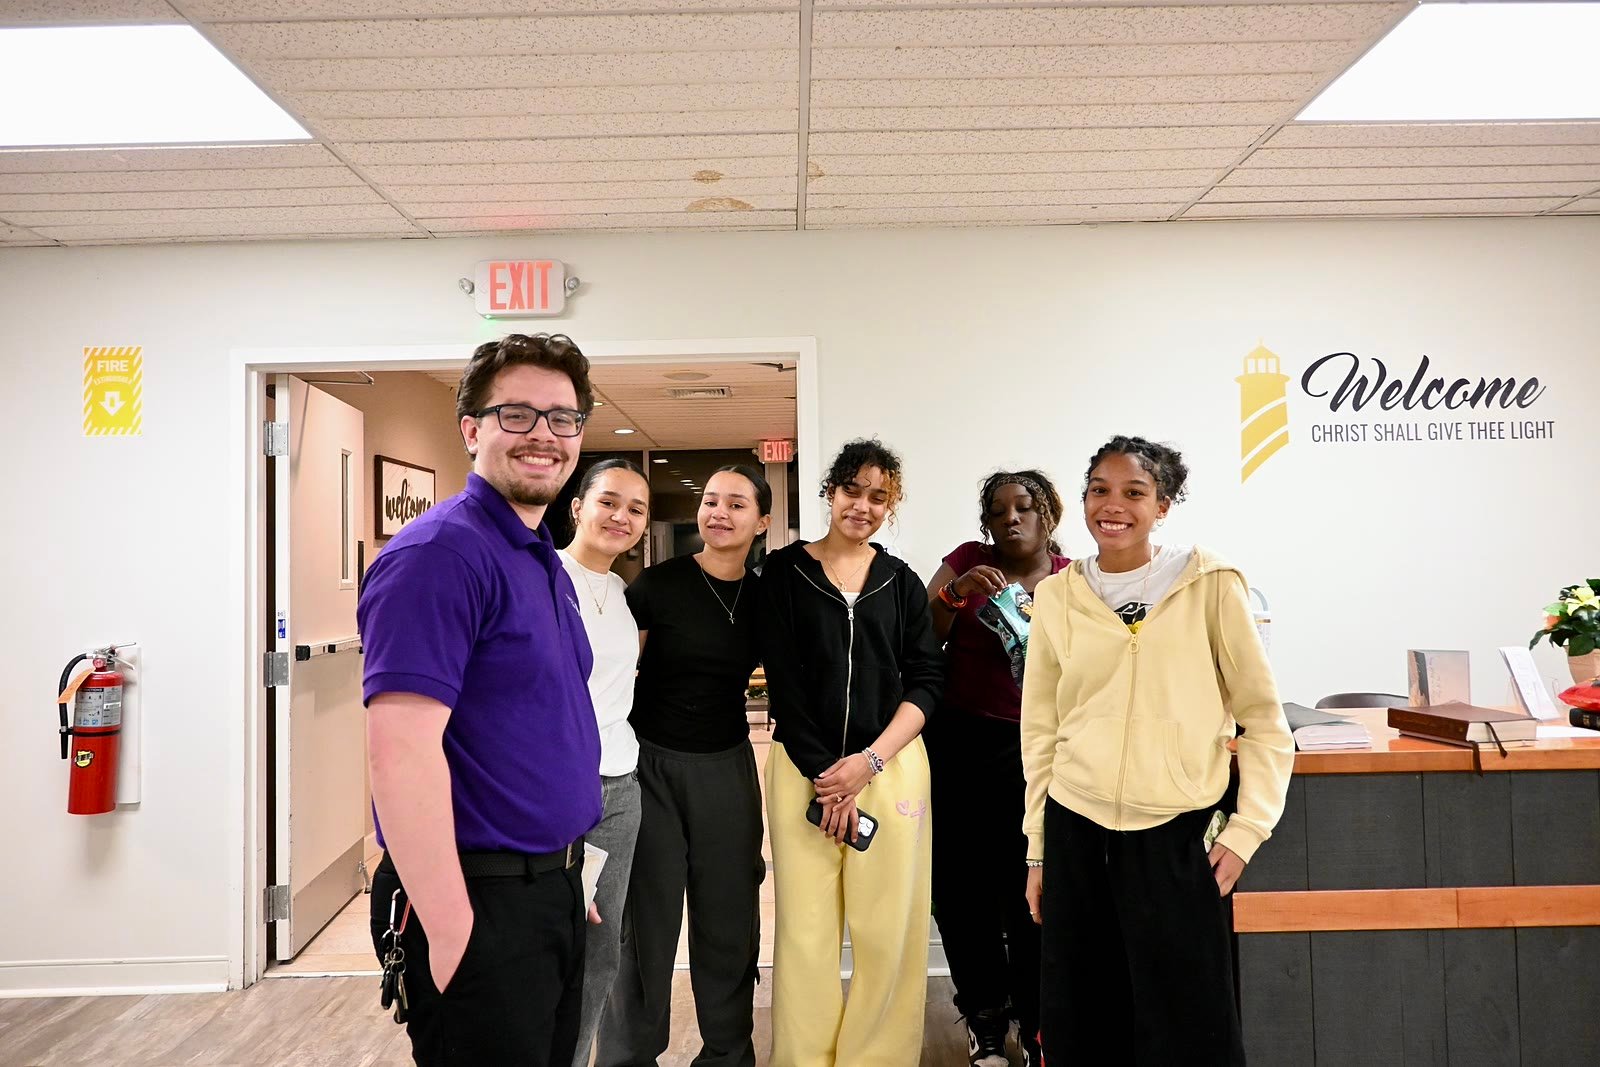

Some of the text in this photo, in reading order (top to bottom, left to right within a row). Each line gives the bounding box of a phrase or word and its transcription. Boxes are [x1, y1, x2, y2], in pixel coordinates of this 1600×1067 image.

[489, 261, 553, 310] EXIT
[97, 360, 129, 372] FIRE
[1301, 352, 1547, 412] Welcome
[1311, 421, 1555, 443] CHRIST SHALL GIVE THEE LIGHT
[764, 441, 789, 461] EXIT
